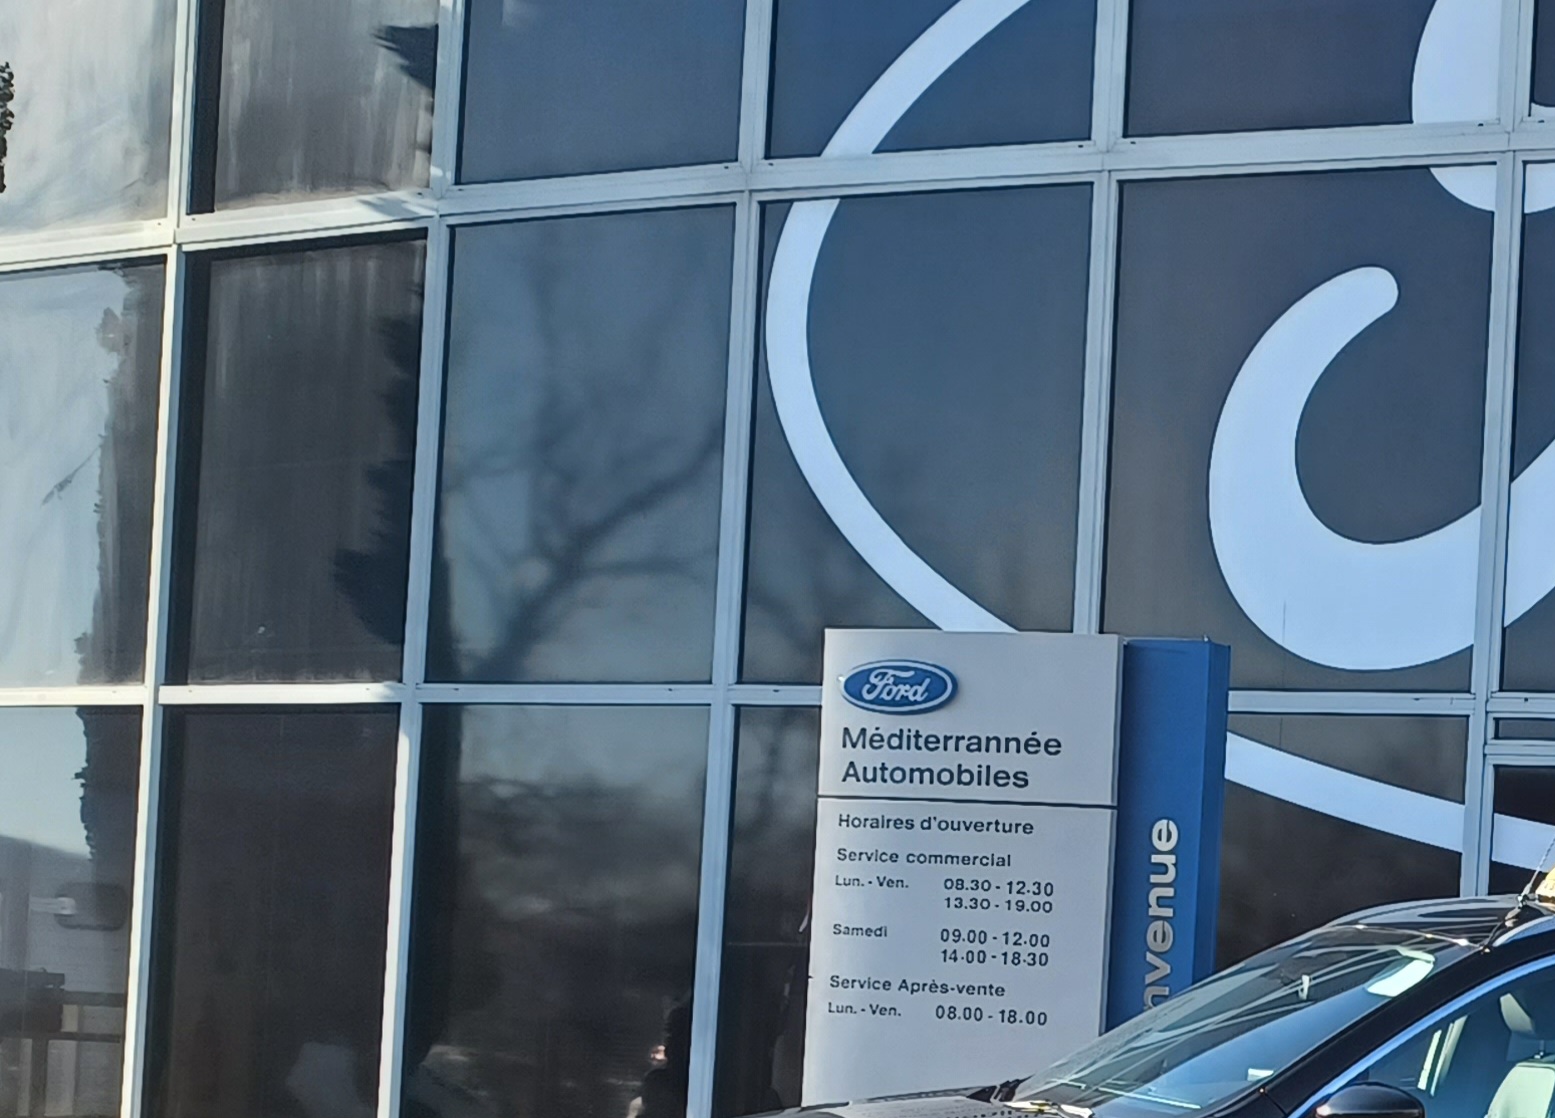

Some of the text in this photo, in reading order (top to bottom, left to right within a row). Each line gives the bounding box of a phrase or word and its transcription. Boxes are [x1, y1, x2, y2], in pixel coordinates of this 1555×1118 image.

[861, 667, 931, 702] Ford
[841, 726, 1062, 757] Méditerrannée
[841, 760, 1030, 789] Automobiles
[838, 814, 1034, 834] Horaires d'ouverture
[837, 848, 1011, 867] Service commercial
[835, 874, 865, 887] Lun.
[876, 875, 909, 888] Ven.
[943, 878, 992, 892] 08.30
[1006, 881, 1054, 897] 12.30
[944, 897, 991, 910] 13.30
[1005, 900, 1053, 914] 19.00
[832, 923, 888, 938] Samedi
[940, 928, 988, 944] 09.00
[1002, 931, 1050, 948] 12.00
[940, 949, 987, 964] 14.00
[1001, 951, 1049, 967] 18.30
[829, 975, 1006, 997] Service Après-vente
[828, 1001, 857, 1014] Lun.
[869, 1003, 902, 1017] Ven.
[935, 1004, 984, 1022] 08.00
[998, 1009, 1048, 1026] 18.00
